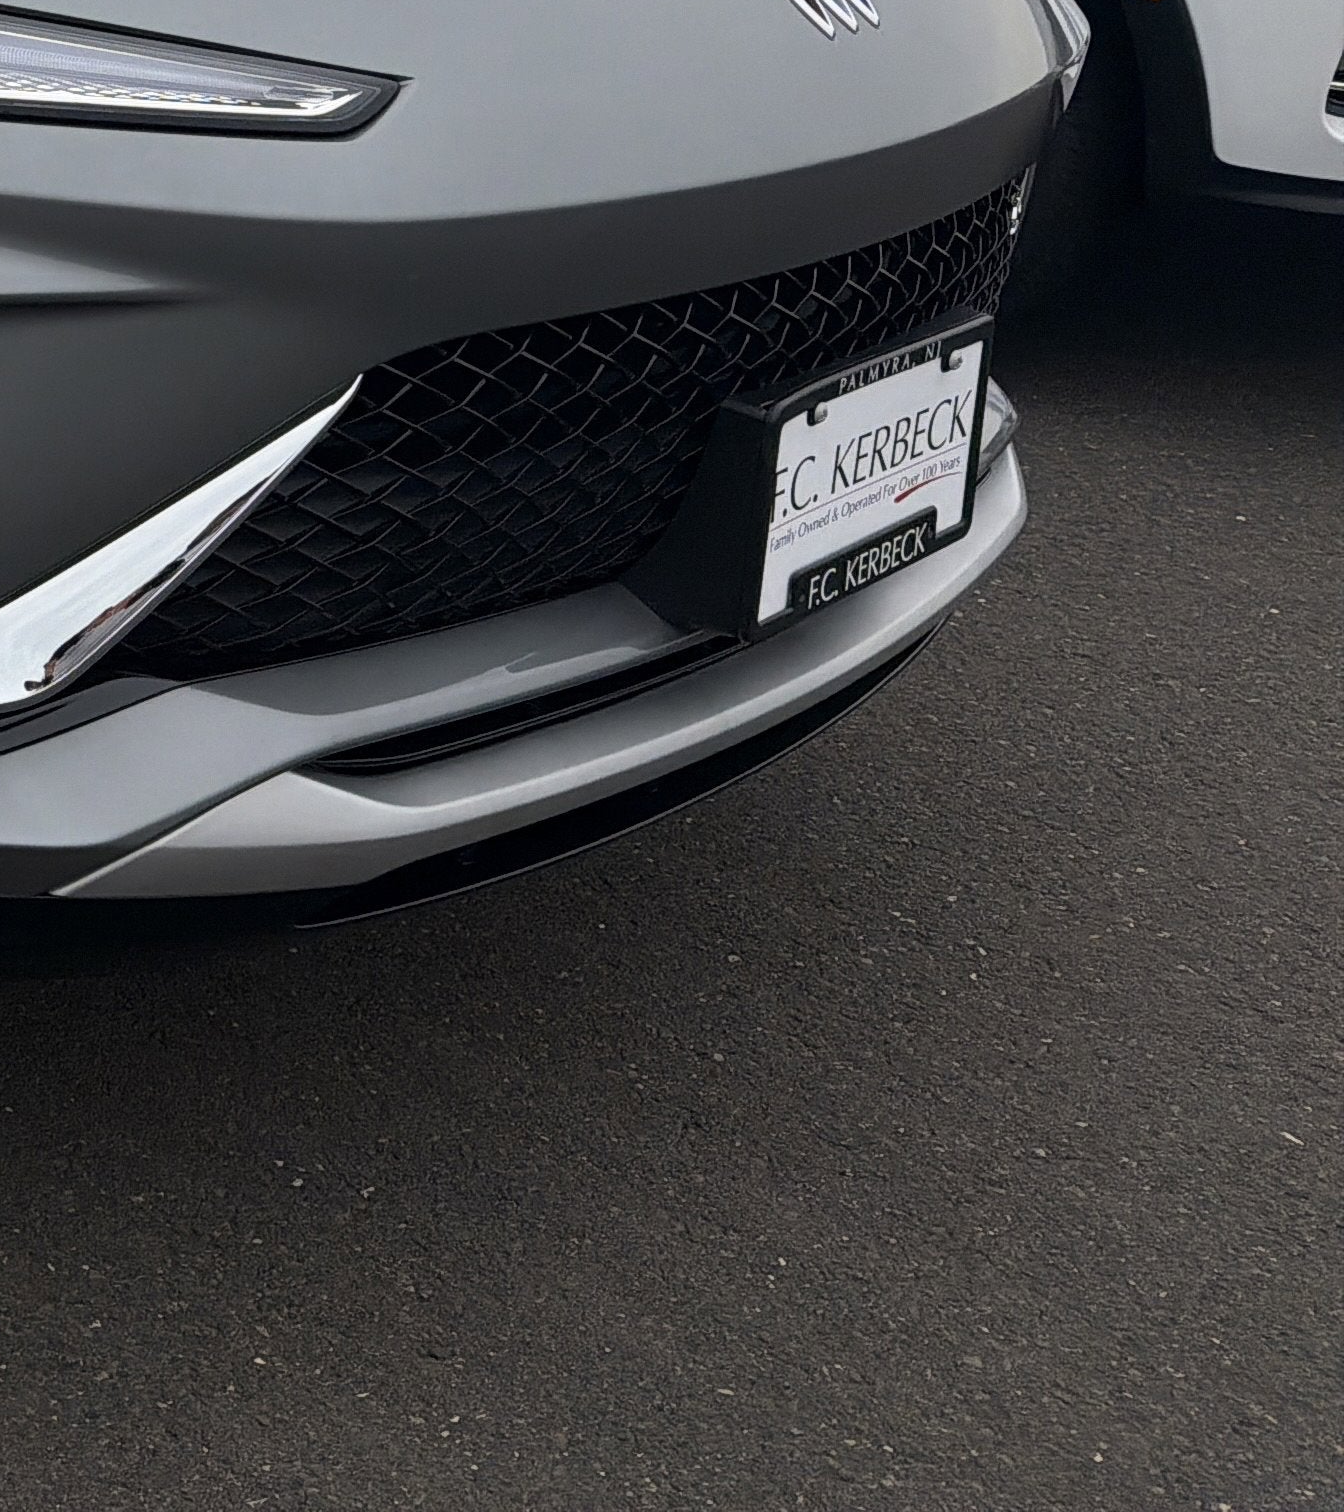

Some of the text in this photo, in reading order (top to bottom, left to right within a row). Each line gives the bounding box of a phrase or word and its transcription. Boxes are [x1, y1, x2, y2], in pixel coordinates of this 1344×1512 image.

[838, 352, 916, 396] PALMYRA,
[830, 390, 973, 495] KERBECK
[798, 509, 831, 537] Owned
[831, 507, 839, 522] &
[840, 492, 881, 518] Operated
[883, 484, 897, 499] For
[899, 474, 920, 491] Over
[922, 466, 937, 481] 100
[939, 456, 961, 473] Years
[807, 522, 928, 610] F.C. KERBECK
